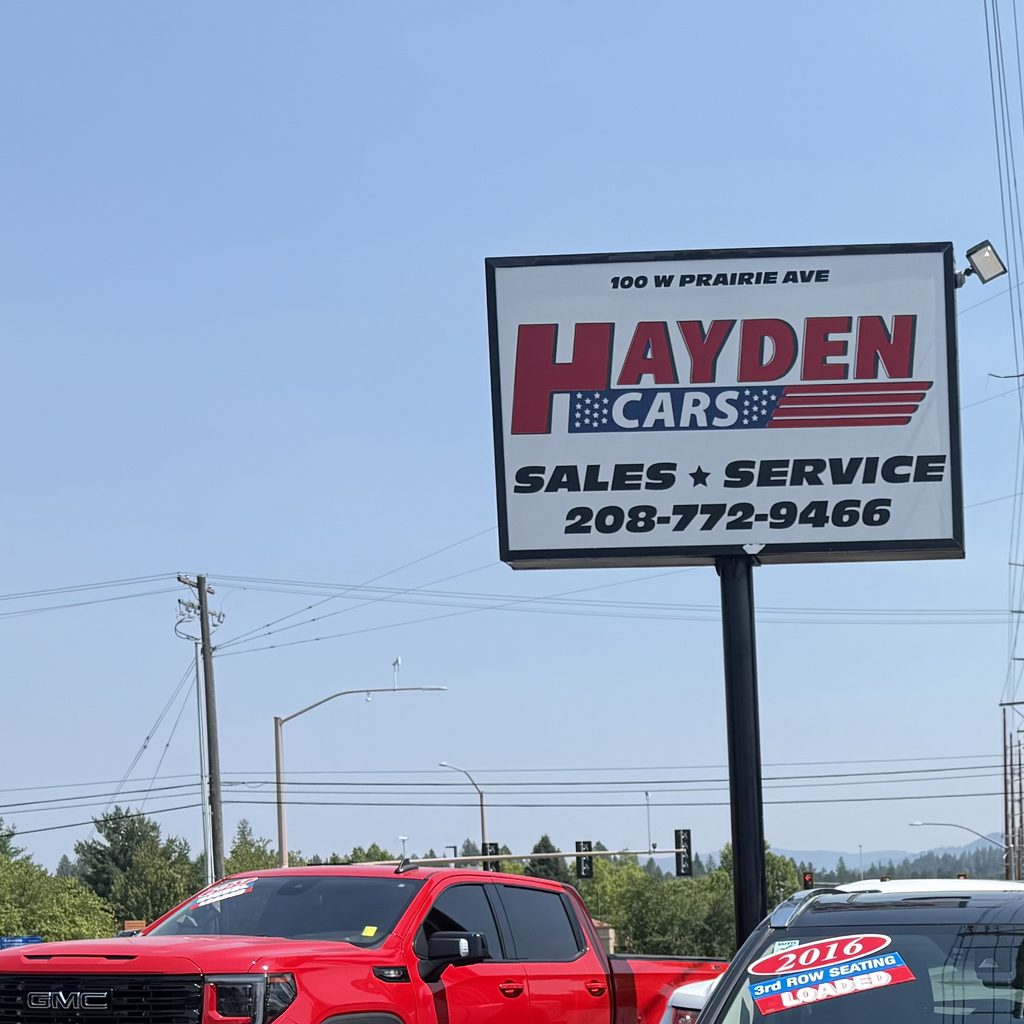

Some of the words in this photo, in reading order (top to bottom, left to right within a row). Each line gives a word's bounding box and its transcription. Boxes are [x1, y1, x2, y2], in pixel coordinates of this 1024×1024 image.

[610, 275, 649, 289] 100
[653, 275, 675, 288] W
[678, 271, 779, 288] PRAIRIE
[781, 269, 831, 284] AVE
[511, 314, 917, 435] HAYDEN
[611, 390, 740, 429] CARS
[513, 462, 678, 494] SALES
[722, 455, 947, 489] SERVICE
[563, 498, 892, 535] 208-772-9466
[775, 936, 865, 973] 2016
[754, 980, 782, 996] 3rd
[786, 970, 825, 986] ROW
[829, 955, 896, 977] SEATING
[780, 971, 892, 1008] LOADED
[27, 991, 108, 1010] GMC
